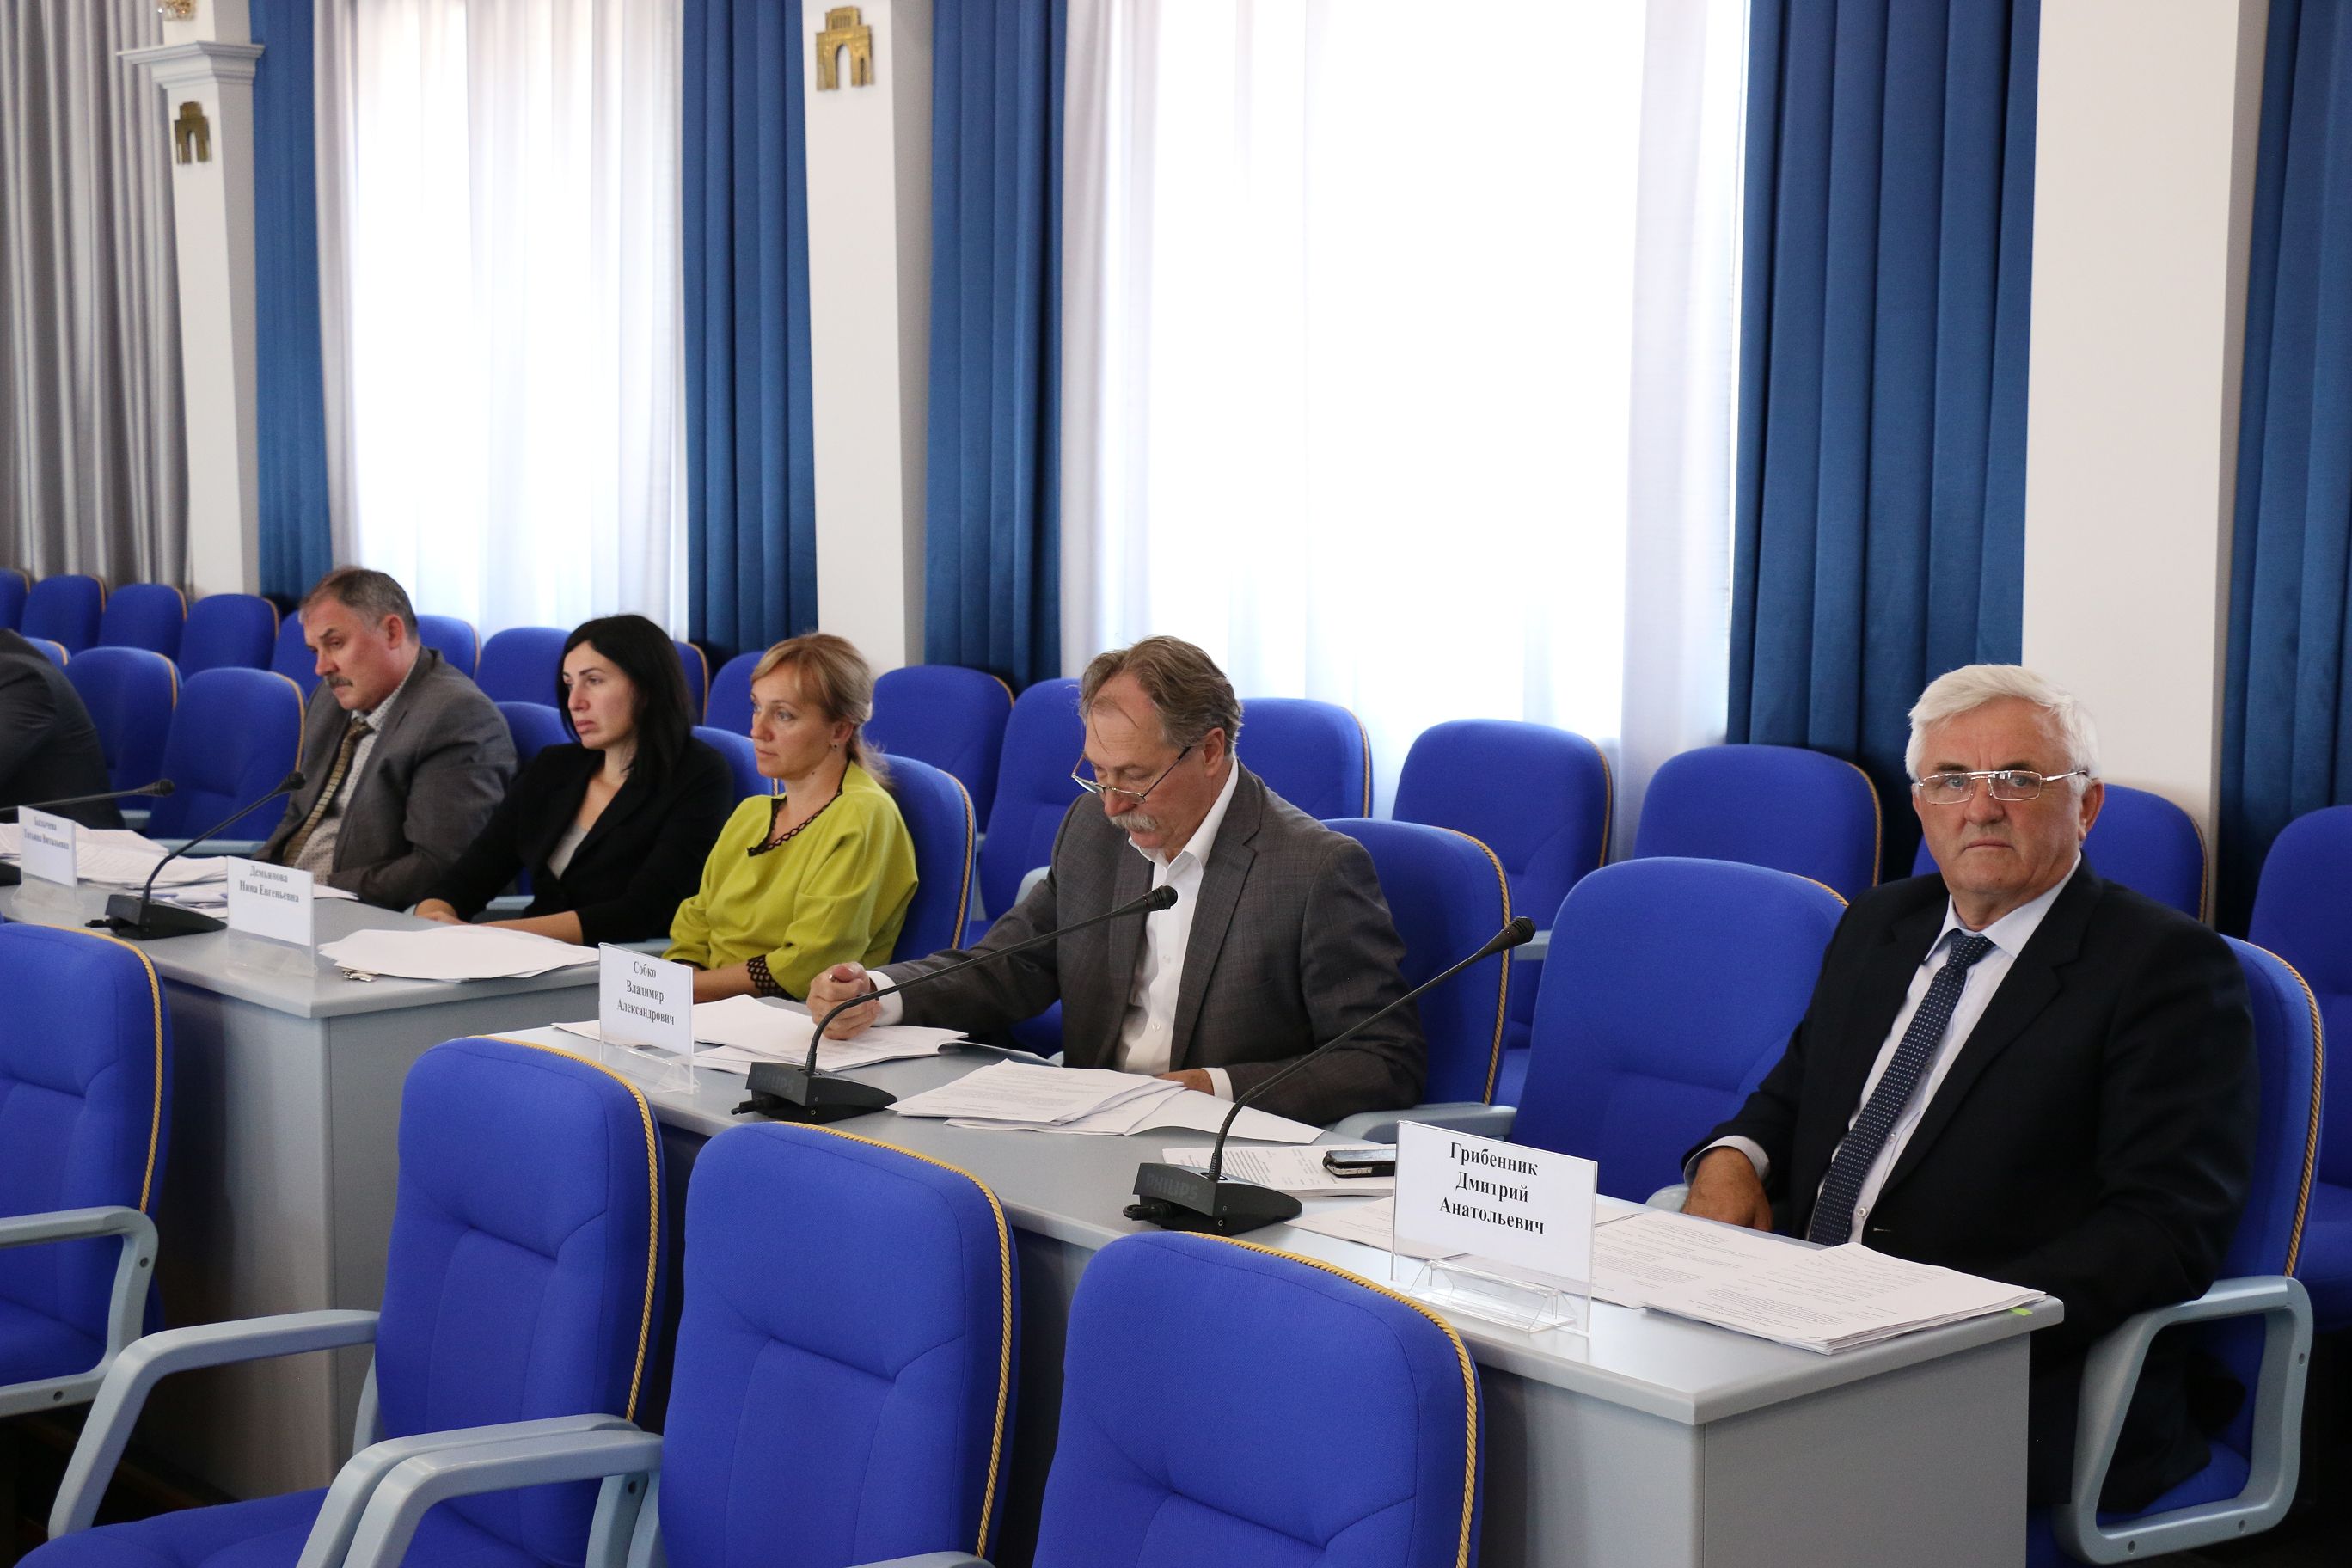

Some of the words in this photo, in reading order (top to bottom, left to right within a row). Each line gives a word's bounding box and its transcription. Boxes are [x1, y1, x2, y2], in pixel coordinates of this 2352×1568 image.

[239, 879, 258, 894] Нина
[260, 884, 299, 903] Евгеньевна
[633, 960, 657, 978] Собко
[626, 979, 665, 1005] Владимир
[617, 998, 675, 1026] Александрович
[1449, 1141, 1539, 1177] Грибенник
[1146, 1171, 1198, 1201] PHILIPS
[1455, 1171, 1529, 1204] Дмитрий
[1439, 1196, 1545, 1234] Анатольевич
